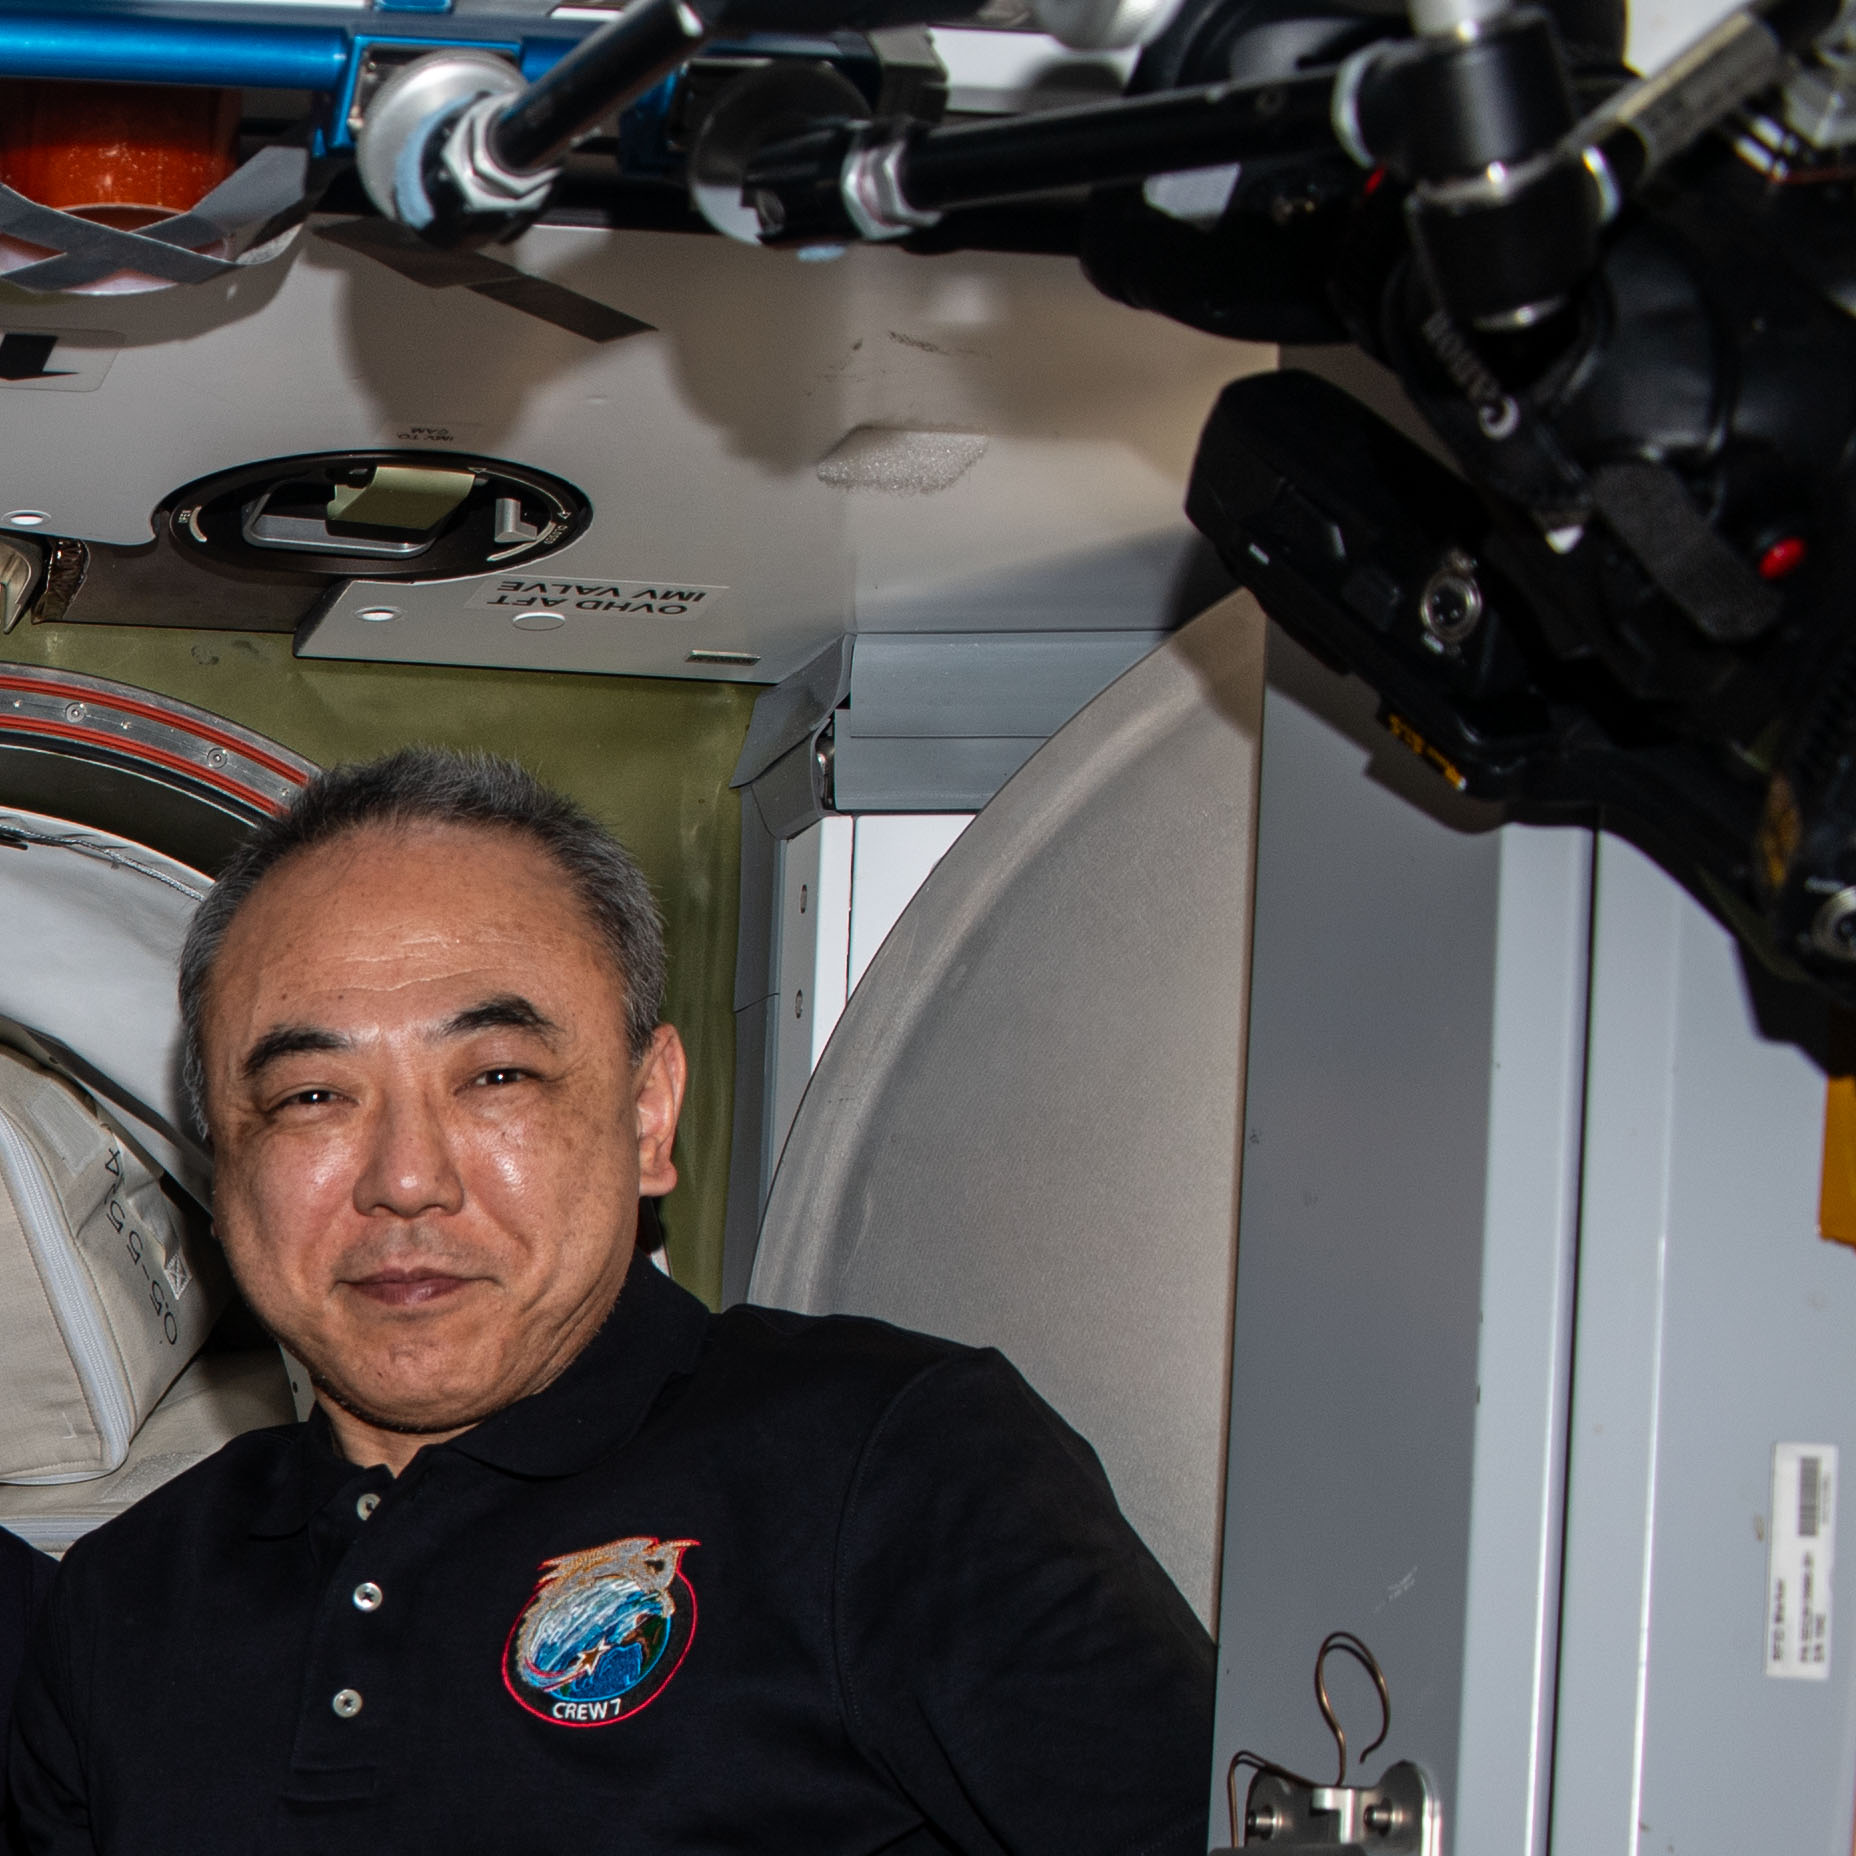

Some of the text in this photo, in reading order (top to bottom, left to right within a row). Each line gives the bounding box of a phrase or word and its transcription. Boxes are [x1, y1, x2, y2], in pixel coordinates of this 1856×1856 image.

[483, 592, 688, 617] OVHD AFT
[495, 580, 708, 605] IMV VALVE
[552, 1697, 622, 1721] CREW 7
